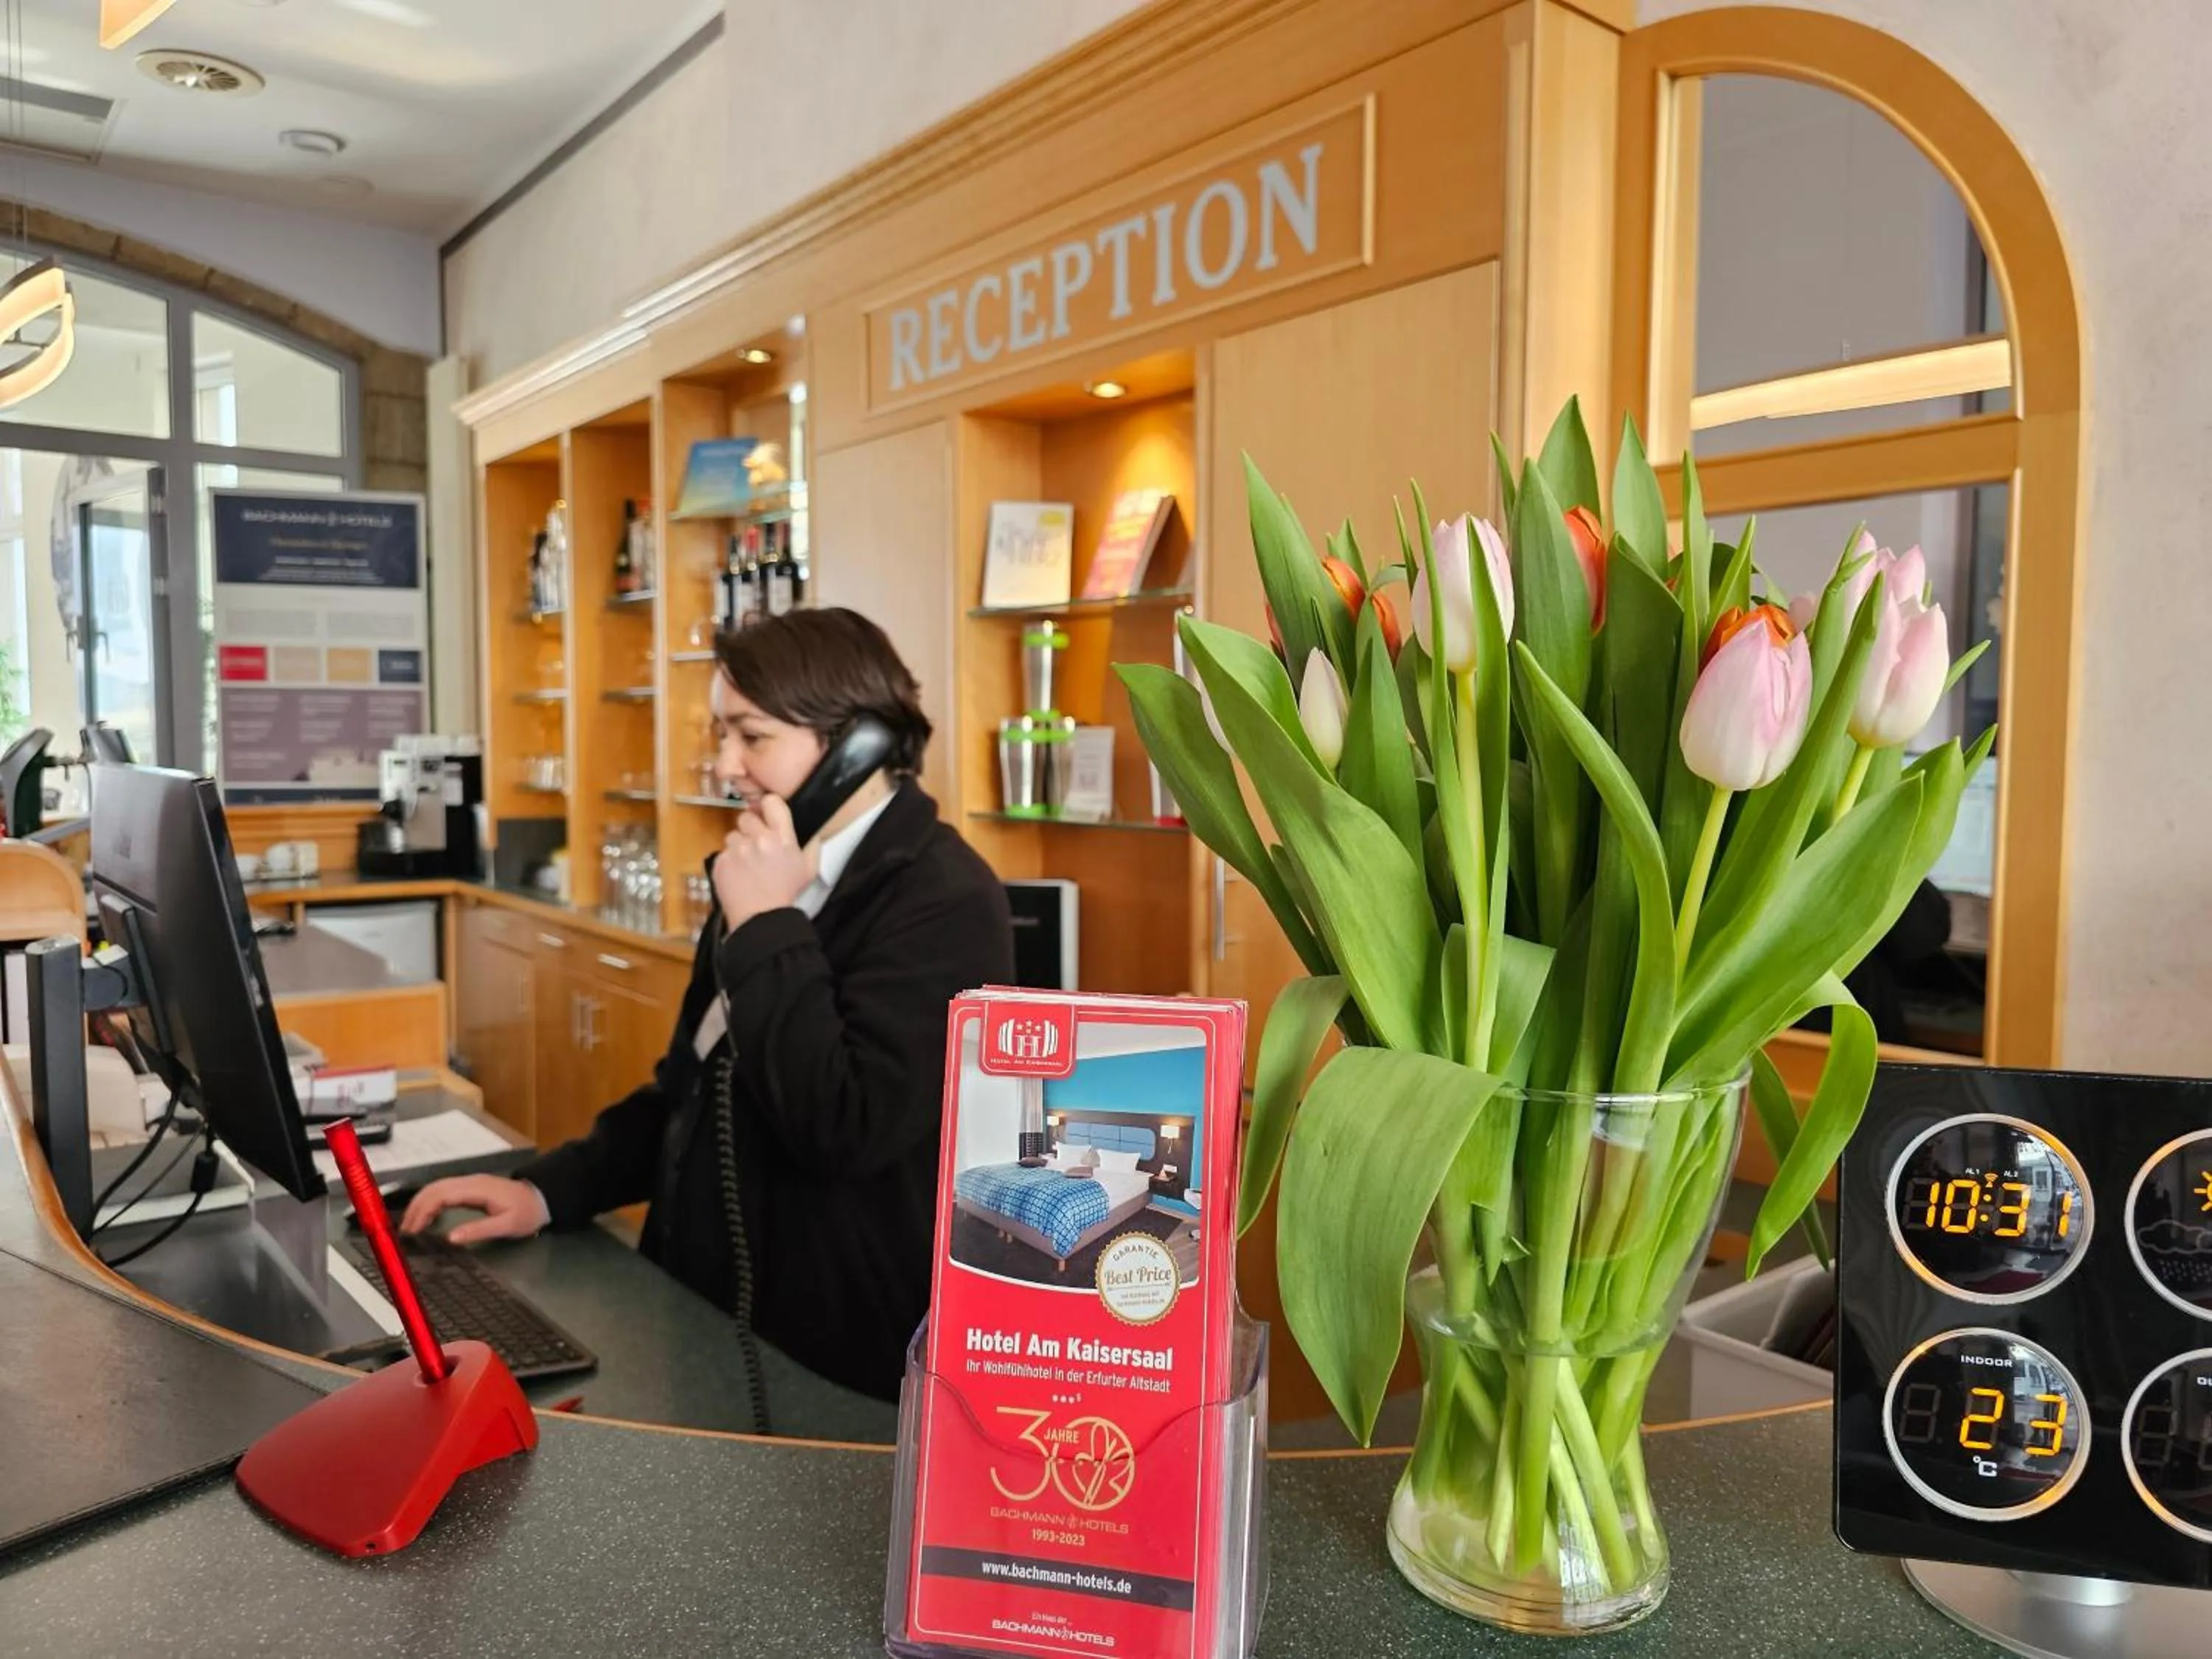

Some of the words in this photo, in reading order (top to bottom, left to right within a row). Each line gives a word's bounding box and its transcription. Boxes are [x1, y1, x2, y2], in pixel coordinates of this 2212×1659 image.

[889, 144, 1323, 390] RECEPTION
[1113, 1244, 1158, 1262] GARANTIE
[1105, 1270, 1133, 1285] Best
[1136, 1266, 1171, 1283] Price
[967, 1328, 1021, 1354] Hotel
[1026, 1333, 1060, 1358] Am
[1067, 1337, 1173, 1371] Kaisersaal
[1961, 1355, 2013, 1368] INDOOR
[966, 1359, 981, 1372] Ihr
[984, 1360, 1052, 1380] Wohlfühlhotel
[1055, 1366, 1064, 1381] in
[1066, 1368, 1084, 1384] der
[1087, 1371, 1127, 1389] Erfurter
[1130, 1374, 1171, 1394] Altstadt
[1043, 1427, 1079, 1444] JAHRE
[990, 1506, 1065, 1526] BACHMANN
[1080, 1520, 1129, 1534] HOTELS
[1032, 1528, 1085, 1546] 1993-2023
[981, 1561, 1132, 1594] www.bachmann-hotels.de
[992, 1619, 1060, 1638] BACHMANN
[1070, 1632, 1116, 1647] HOTELS
